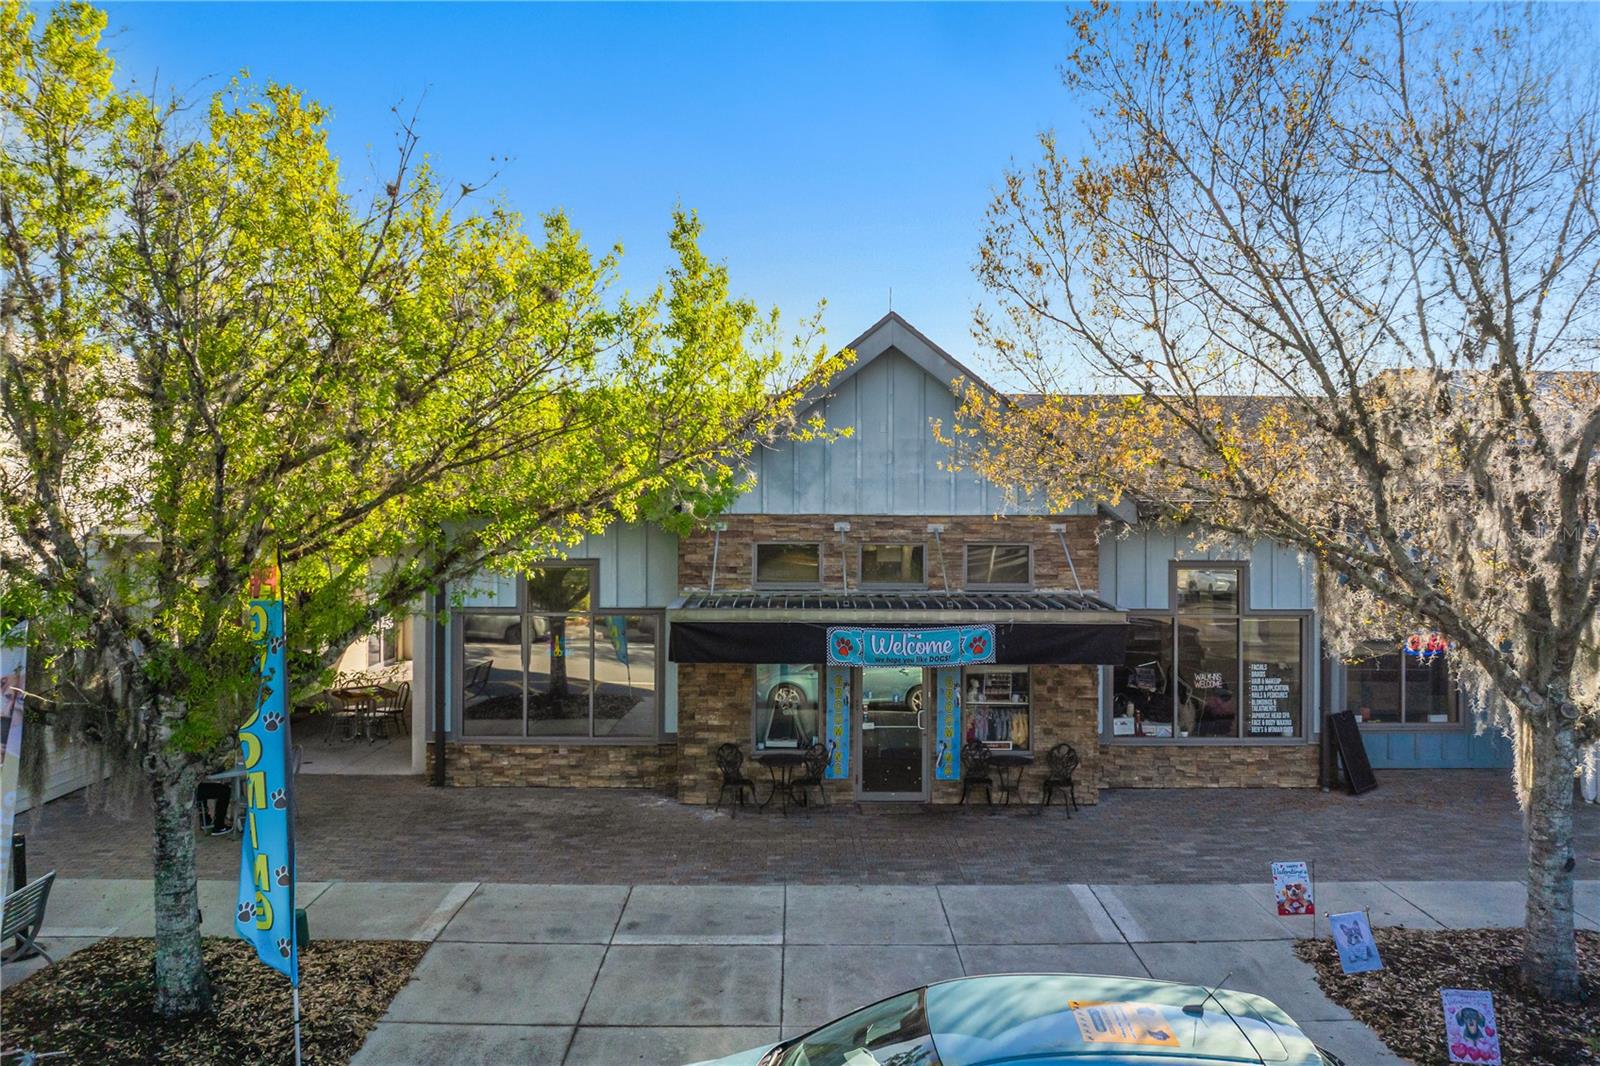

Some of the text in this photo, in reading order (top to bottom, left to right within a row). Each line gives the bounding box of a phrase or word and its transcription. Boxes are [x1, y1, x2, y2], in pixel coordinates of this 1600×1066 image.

[871, 632, 954, 657] Welcome
[929, 654, 951, 663] DOGS!
[1194, 672, 1222, 681] WALK-INS
[1194, 680, 1223, 688] WELCOME
